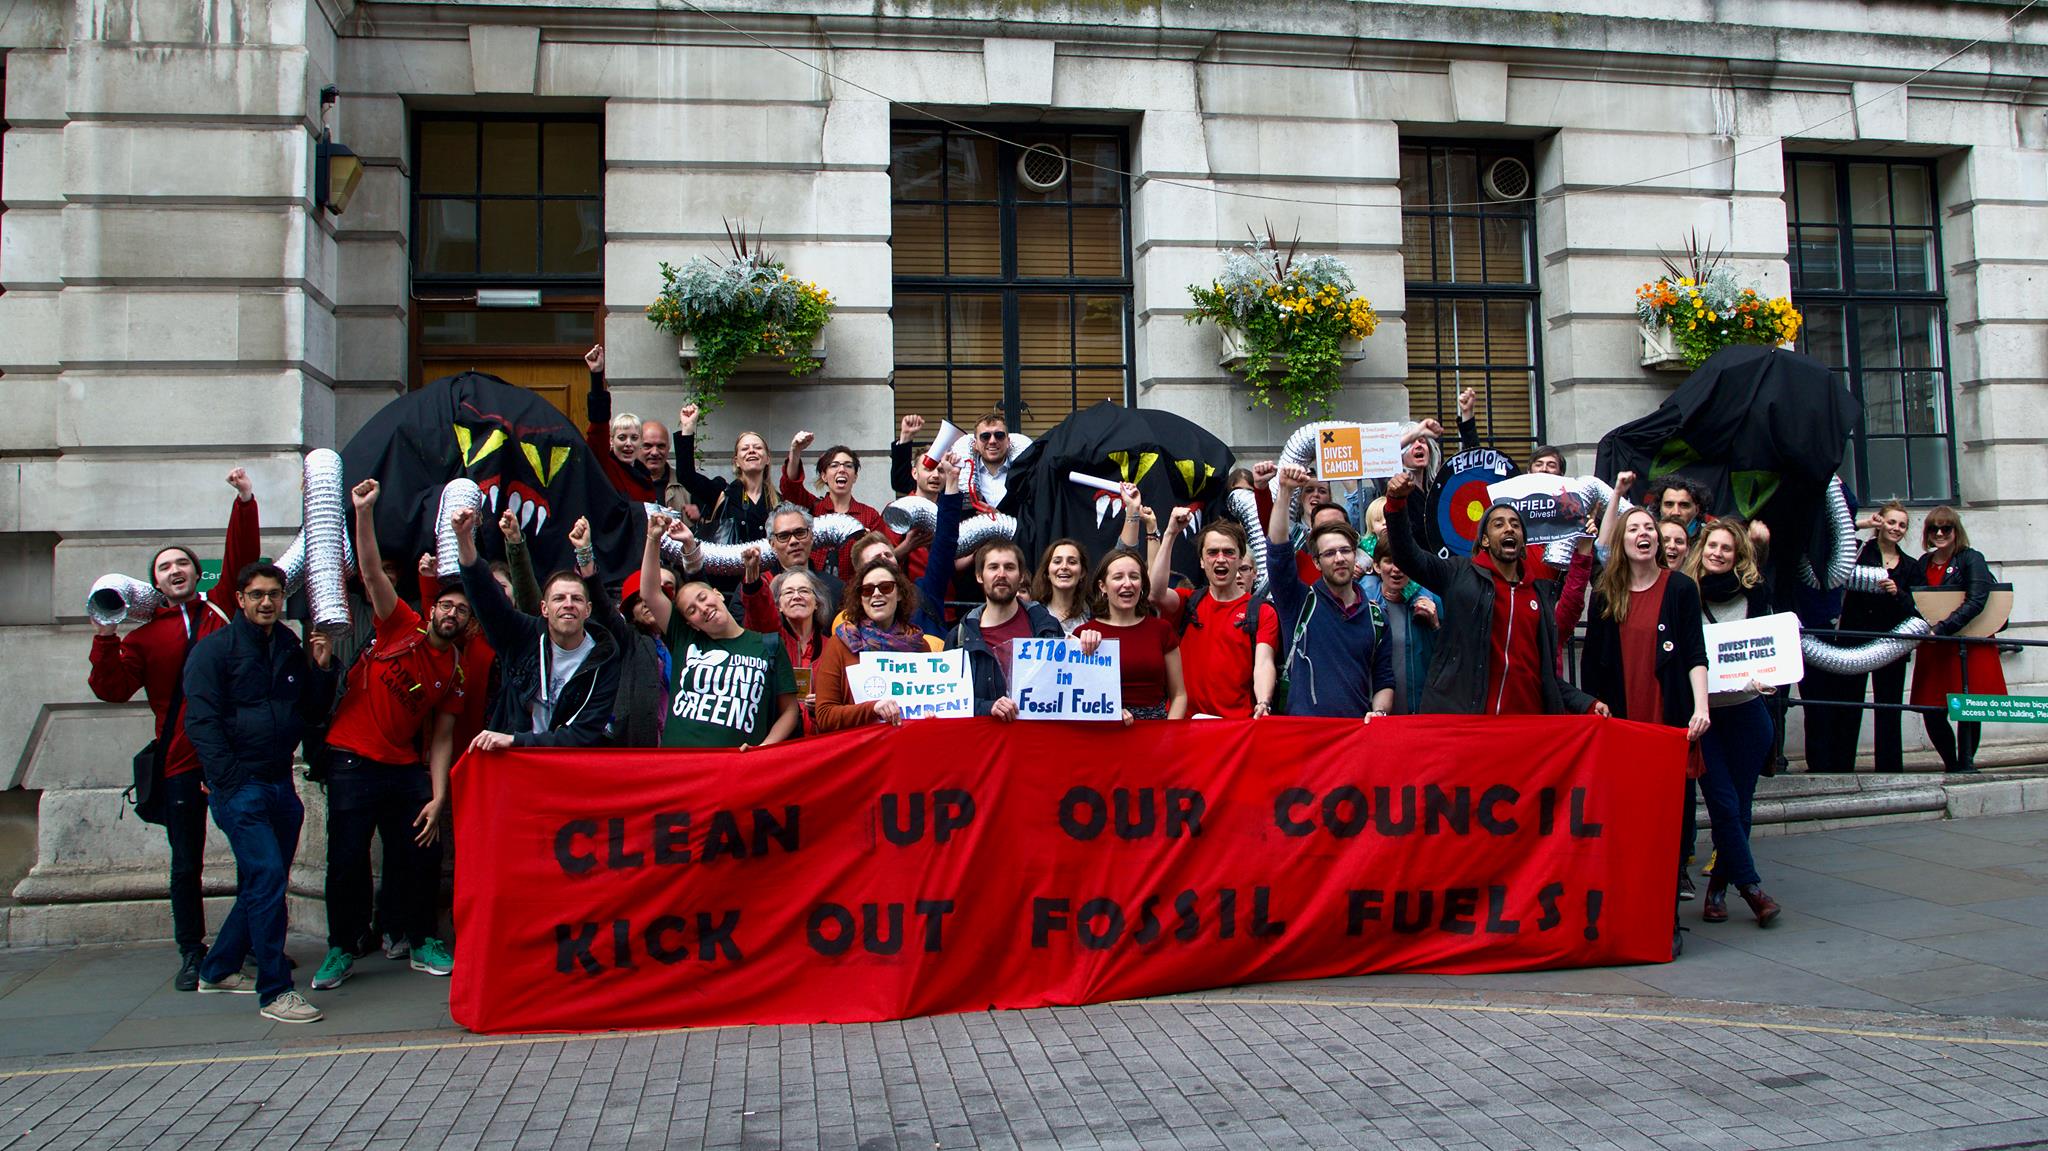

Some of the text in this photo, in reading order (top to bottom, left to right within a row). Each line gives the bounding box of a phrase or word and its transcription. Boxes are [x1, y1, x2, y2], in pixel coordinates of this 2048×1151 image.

[1323, 445, 1353, 460] DIVEST
[1324, 459, 1359, 474] CAMDEN
[1454, 452, 1506, 472] £110m
[1507, 498, 1556, 512] NFIELD
[1529, 509, 1557, 519] Divest!
[1018, 640, 1067, 662] £110
[1718, 636, 1774, 653] DIVEST FROM
[729, 653, 768, 673] LONDON
[1717, 647, 1776, 664] FOSSIL FUELS
[1056, 668, 1073, 685] in
[898, 698, 969, 719] AMDEN!
[1018, 687, 1114, 714] Fossil Fuels
[1965, 698, 1988, 707] Please
[1989, 699, 1999, 707] do
[2013, 700, 2031, 708] leave
[672, 689, 759, 734] GREENS
[1987, 709, 1995, 717] to
[1996, 709, 2008, 717] the
[2009, 710, 2036, 719] building.
[553, 783, 1604, 876] CLEAN UP OUR COUNCIL
[554, 881, 1604, 977] KICK OUT FOSSIL FUELS!
